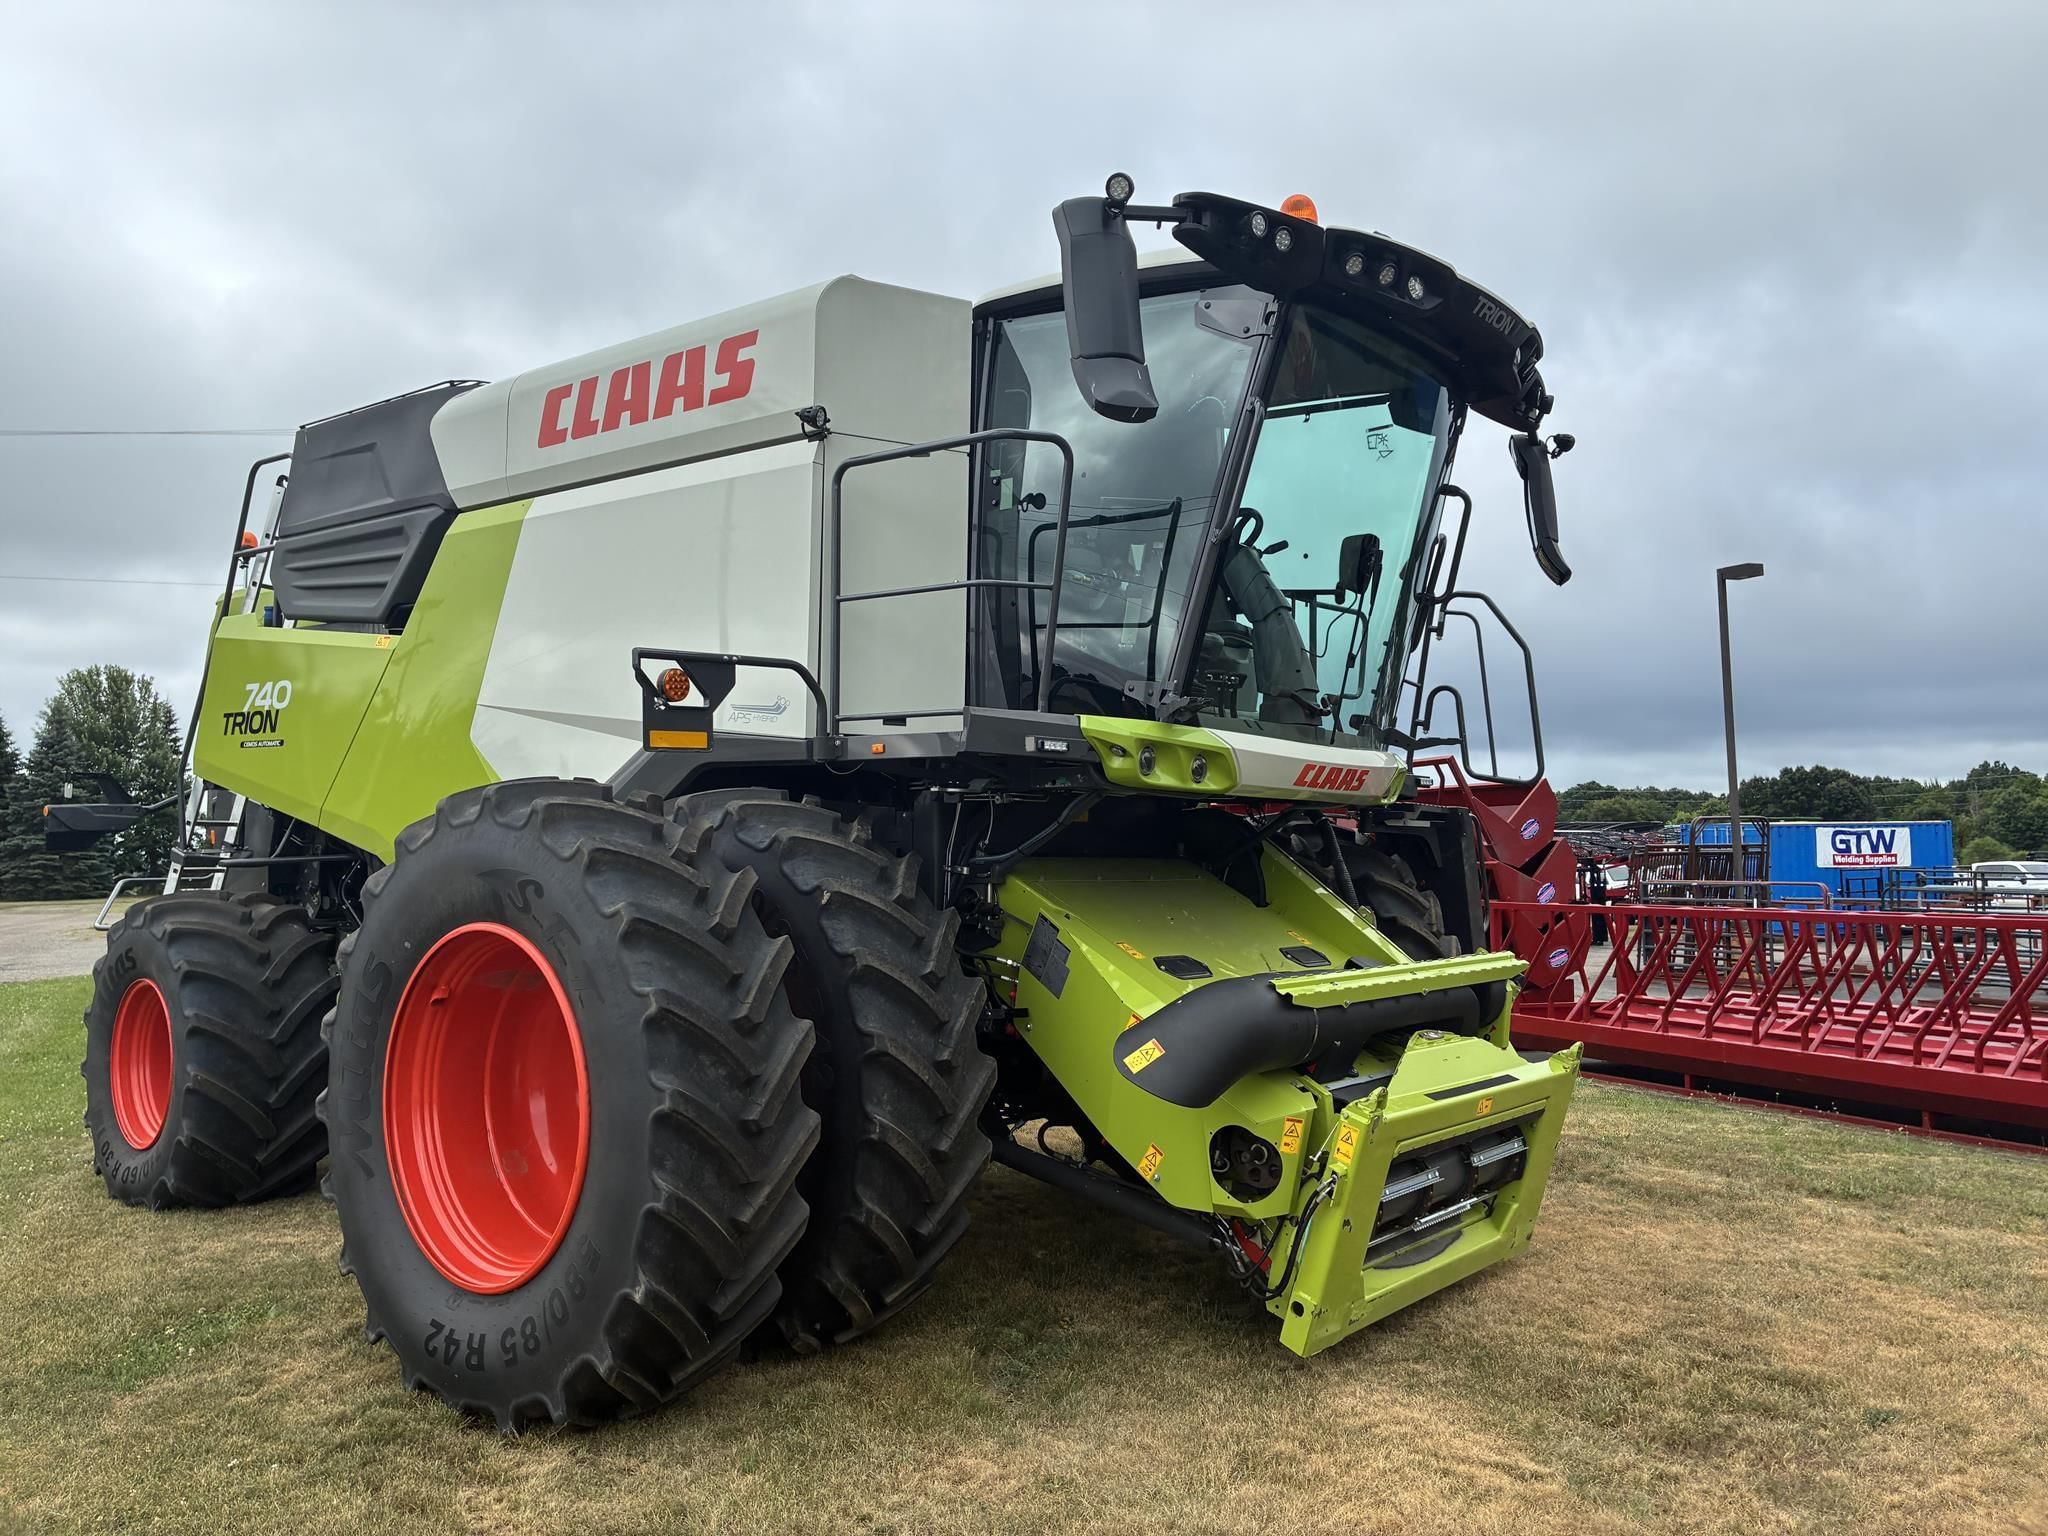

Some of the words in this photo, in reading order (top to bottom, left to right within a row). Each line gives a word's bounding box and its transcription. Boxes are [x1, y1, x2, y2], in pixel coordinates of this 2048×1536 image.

[1473, 295, 1515, 335] TRION
[537, 328, 760, 449] CLAAS
[242, 679, 292, 712] 740
[223, 709, 280, 736] TRION
[727, 711, 752, 724] APS
[1293, 763, 1370, 791] CLAAS
[1831, 829, 1896, 854] GTW
[1834, 855, 1864, 865] Welding
[1865, 855, 1896, 864] Supplies
